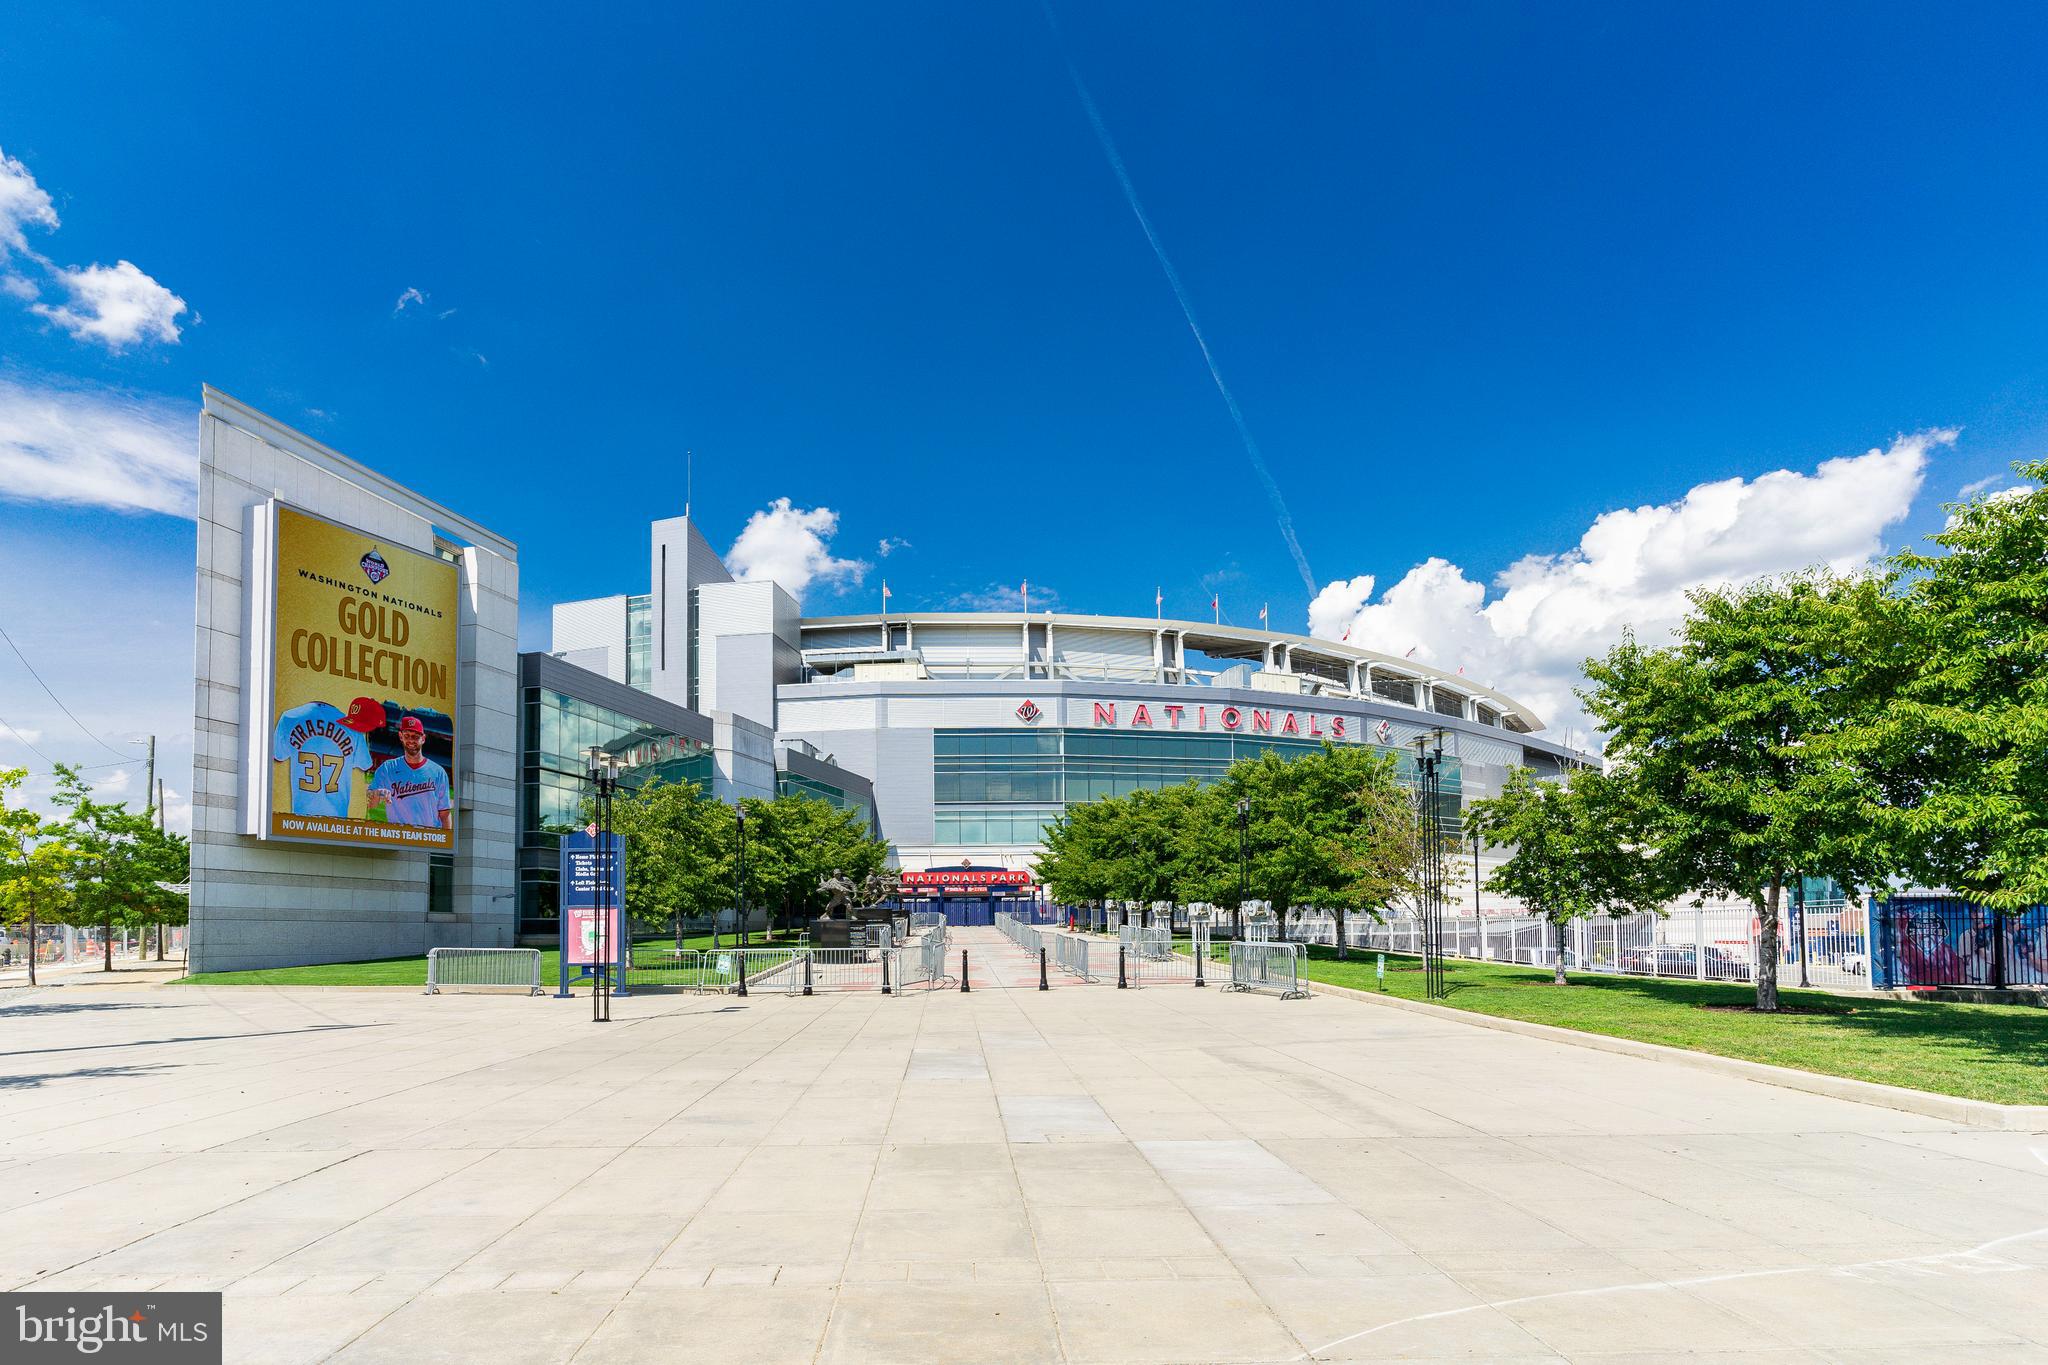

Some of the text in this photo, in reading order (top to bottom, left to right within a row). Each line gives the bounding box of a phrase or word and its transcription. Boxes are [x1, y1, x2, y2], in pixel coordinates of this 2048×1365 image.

[298, 568, 443, 619] WASHINGTON NATIONALS
[338, 596, 410, 647] GOLD
[290, 628, 447, 700] COLLECTION
[289, 719, 354, 757] STRASBURG
[1093, 701, 1346, 738] NATIONALS
[298, 751, 345, 793] 37
[391, 778, 435, 797] Nationals
[282, 819, 447, 843] NOW AVAILABLE AT THE NATS TEAM STORE
[906, 873, 1025, 883] NATIONALS PARK
